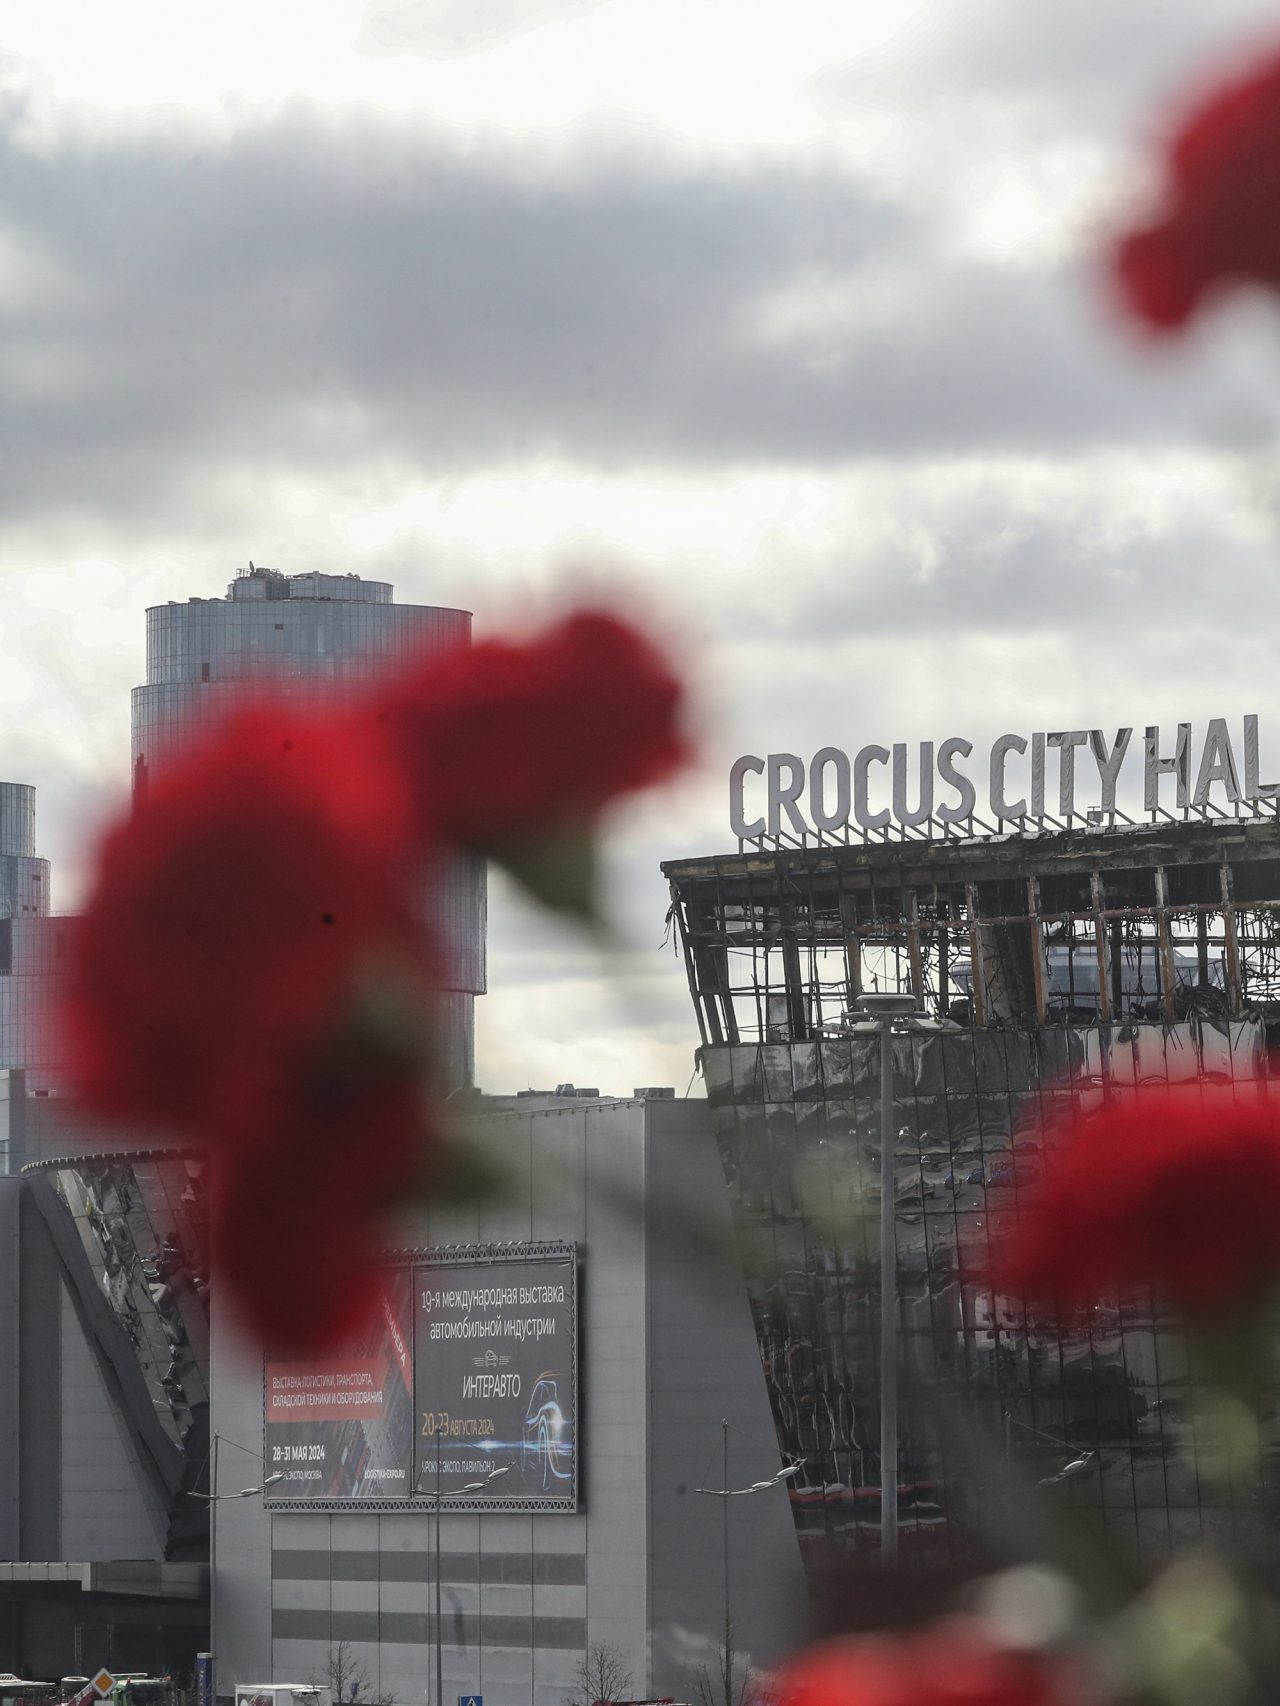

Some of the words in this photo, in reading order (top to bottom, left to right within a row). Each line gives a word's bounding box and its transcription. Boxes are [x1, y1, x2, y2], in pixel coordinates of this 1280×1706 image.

[729, 737, 977, 840] CROCUS
[990, 727, 1133, 821] CITY
[421, 1290, 440, 1313] 19-я
[442, 1287, 518, 1312] международная
[519, 1285, 564, 1304] выставка
[430, 1314, 501, 1339] автомобильной
[504, 1317, 556, 1342] индустрии
[272, 1376, 301, 1389] ВЫСТАВКА
[462, 1374, 521, 1399] ИНТЕРАВТО
[272, 1392, 306, 1408] СКЛАДСКОЙ
[306, 1393, 331, 1406] ТЕХНИКИ
[336, 1391, 383, 1406] ОБОРУДОВАНИЯ
[450, 1419, 478, 1436] АВГУСТА
[478, 1418, 495, 1435] 2024
[272, 1446, 291, 1461] 28-31
[292, 1445, 308, 1460] МАЯ
[308, 1445, 325, 1460] 2024
[461, 1460, 491, 1473] ПАВИЛЬОН
